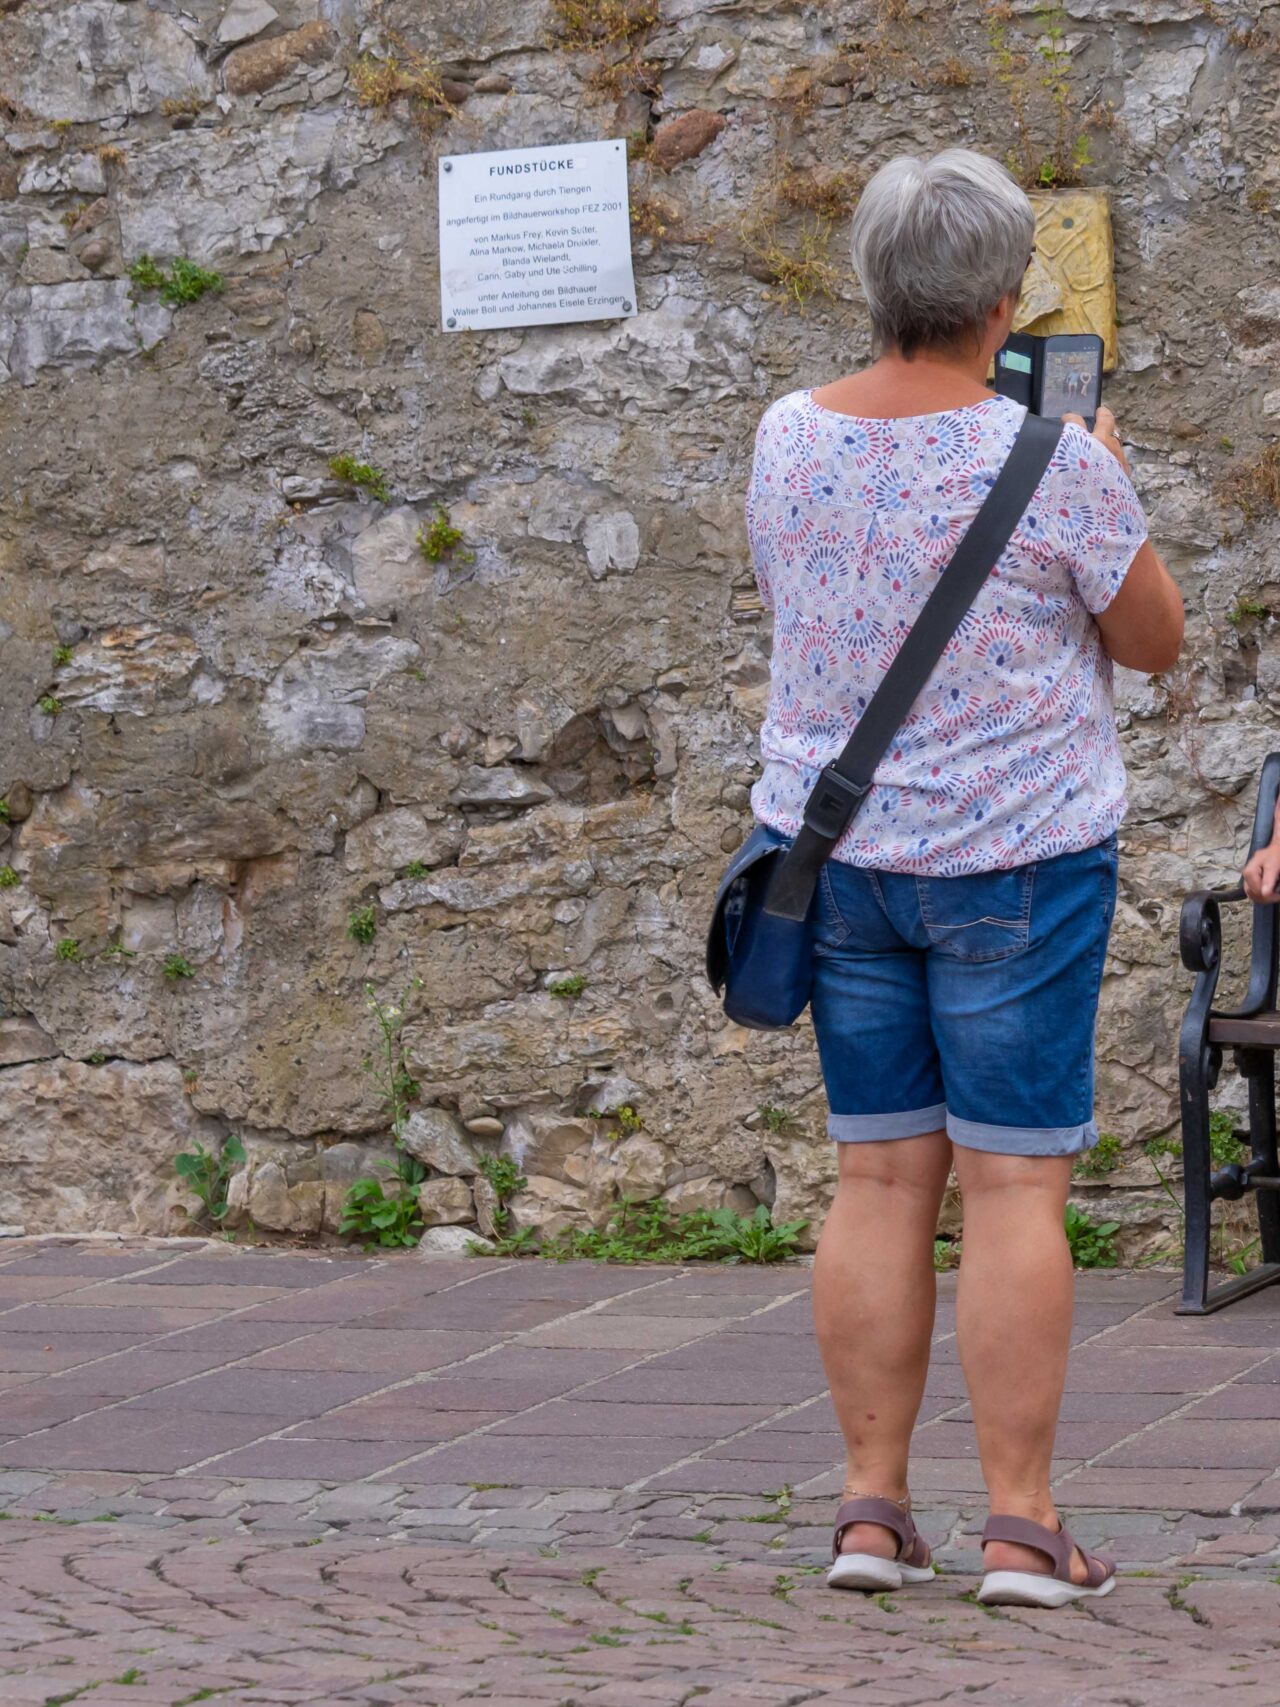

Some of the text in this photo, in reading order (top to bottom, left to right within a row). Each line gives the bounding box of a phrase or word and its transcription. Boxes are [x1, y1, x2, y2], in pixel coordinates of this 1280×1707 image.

[489, 159, 574, 177] FUNDSTÜCKE
[474, 185, 592, 203] Ein Rundgang durch Tiengen
[446, 202, 622, 227] angefertigt im Bildhauerworkshop FEZ 2001
[474, 236, 489, 244] von
[491, 233, 521, 242] Markus
[545, 228, 569, 237] Kevin
[469, 248, 490, 257] Alina
[492, 246, 525, 255] Markow,
[528, 241, 565, 251] Michaela
[504, 270, 526, 279] Gaby
[528, 268, 544, 277] und
[546, 267, 561, 276] Ute
[478, 286, 597, 302] unter Anleitung der Bildhauer
[500, 304, 515, 313] und
[517, 301, 557, 312] Johannes
[559, 298, 585, 308] Eisele
[587, 295, 625, 306] Erzingen
